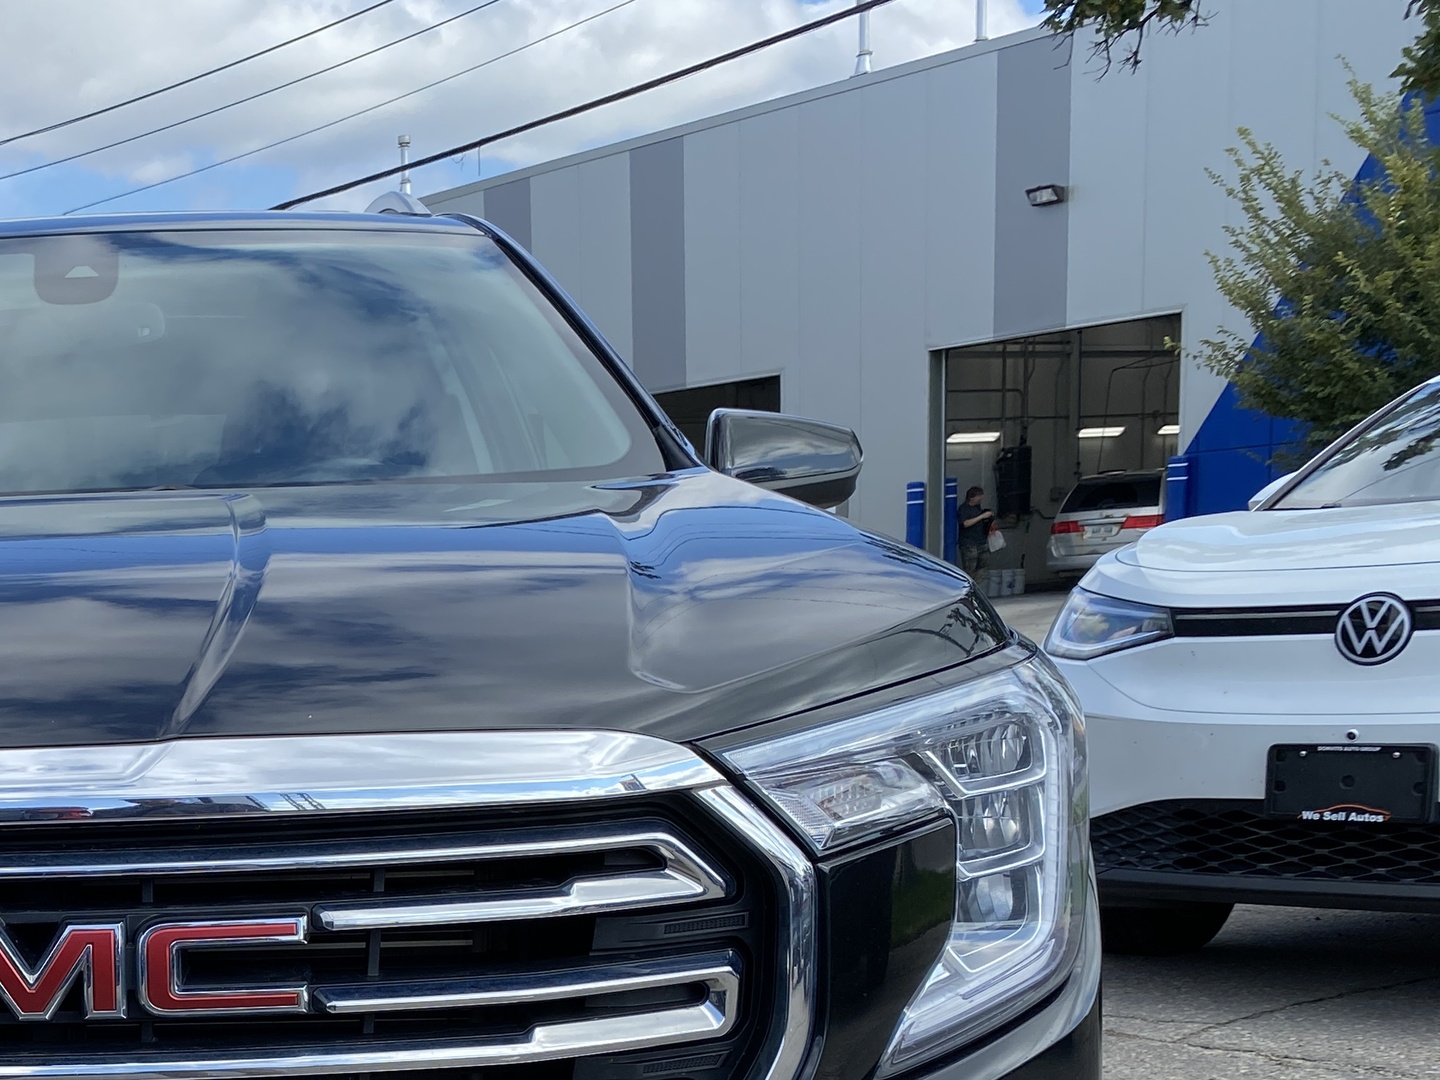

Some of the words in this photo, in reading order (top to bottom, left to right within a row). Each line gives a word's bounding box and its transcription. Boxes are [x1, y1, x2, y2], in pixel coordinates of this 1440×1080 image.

[1301, 810, 1320, 820] We
[1322, 811, 1347, 821] Sell
[1348, 812, 1384, 823] Autos
